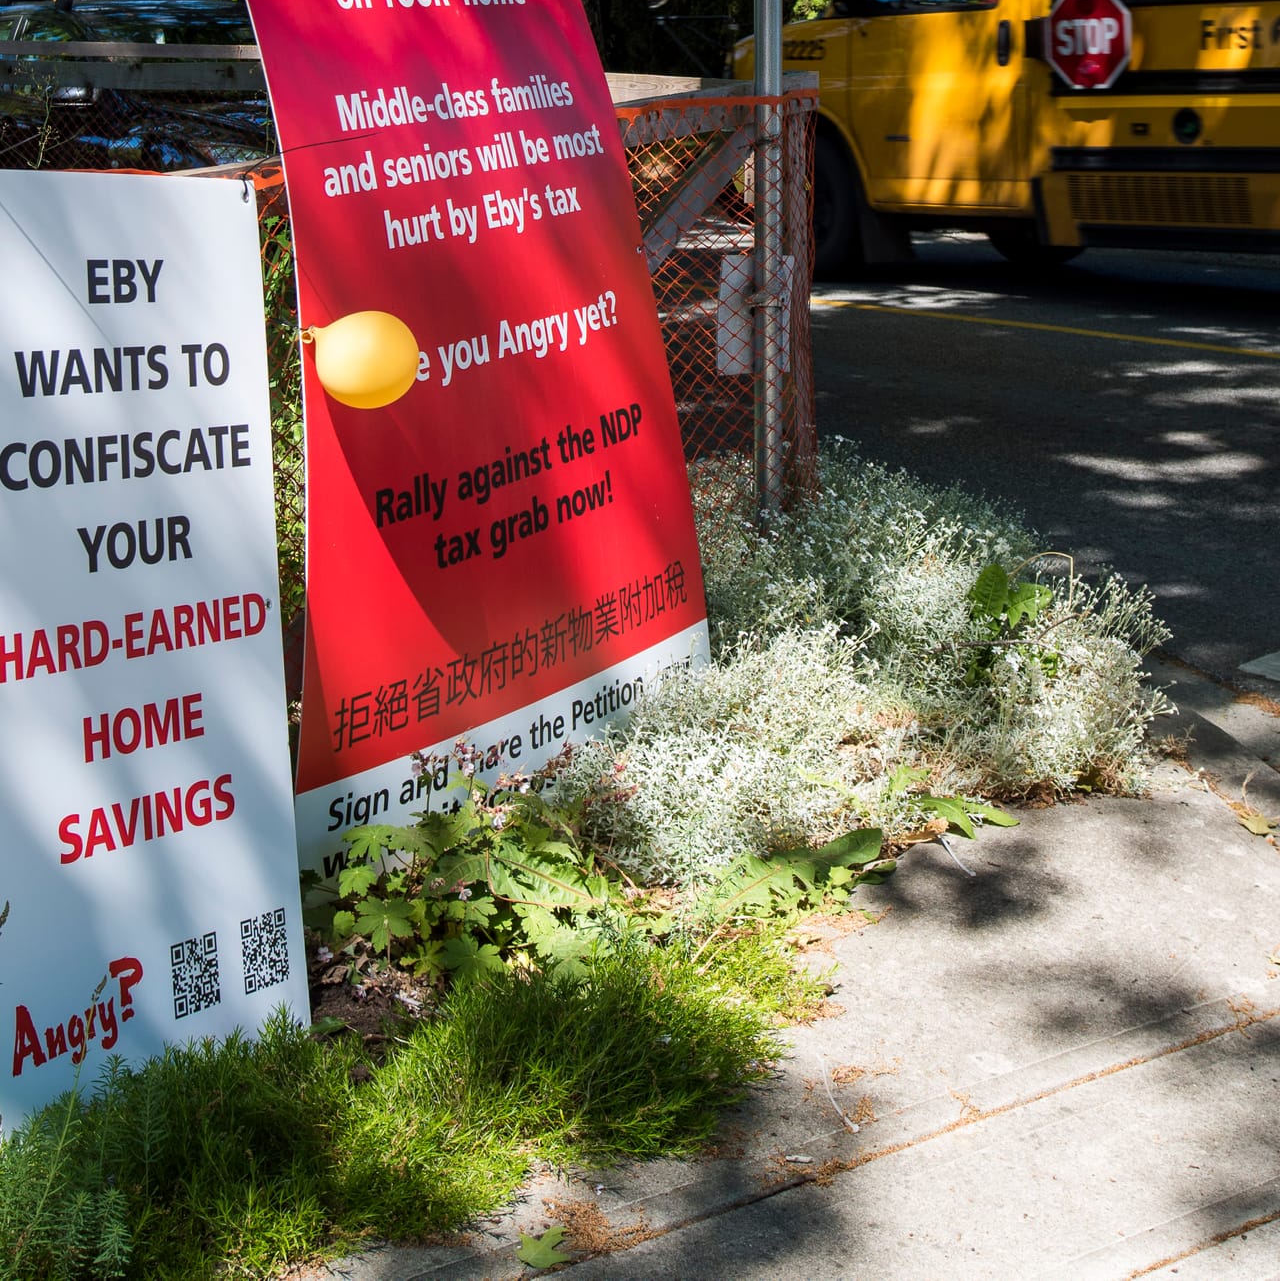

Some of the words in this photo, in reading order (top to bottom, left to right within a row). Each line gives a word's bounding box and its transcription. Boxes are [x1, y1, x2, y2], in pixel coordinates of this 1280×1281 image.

[1055, 17, 1119, 56] STOP
[335, 82, 489, 132] Middle-class
[490, 74, 574, 114] families
[324, 150, 378, 198] and
[383, 143, 473, 188] seniors
[475, 131, 519, 172] will
[519, 130, 550, 165] be
[552, 123, 604, 160] most
[383, 203, 445, 249] hurt
[446, 198, 478, 244] by
[482, 187, 543, 233] Eby's
[544, 184, 581, 216] tax
[86, 259, 164, 304] EBY
[14, 345, 169, 398] WANTS
[181, 342, 230, 387] TO
[437, 334, 490, 386] you
[498, 312, 568, 358] Angry
[574, 290, 618, 345] yet?
[375, 473, 448, 528] Rally
[457, 437, 552, 505] against
[557, 425, 595, 464] the
[600, 403, 642, 448] NDP
[76, 515, 193, 573] YOUR
[434, 527, 482, 568] tax
[490, 496, 549, 559] grab
[556, 470, 614, 524] now!
[82, 692, 205, 763] HOME
[327, 787, 390, 832] Sign
[399, 754, 449, 805] and
[529, 714, 565, 749] the
[572, 676, 644, 731] Petition
[58, 773, 236, 865] SAVINGS
[13, 957, 144, 1078] Angry?
